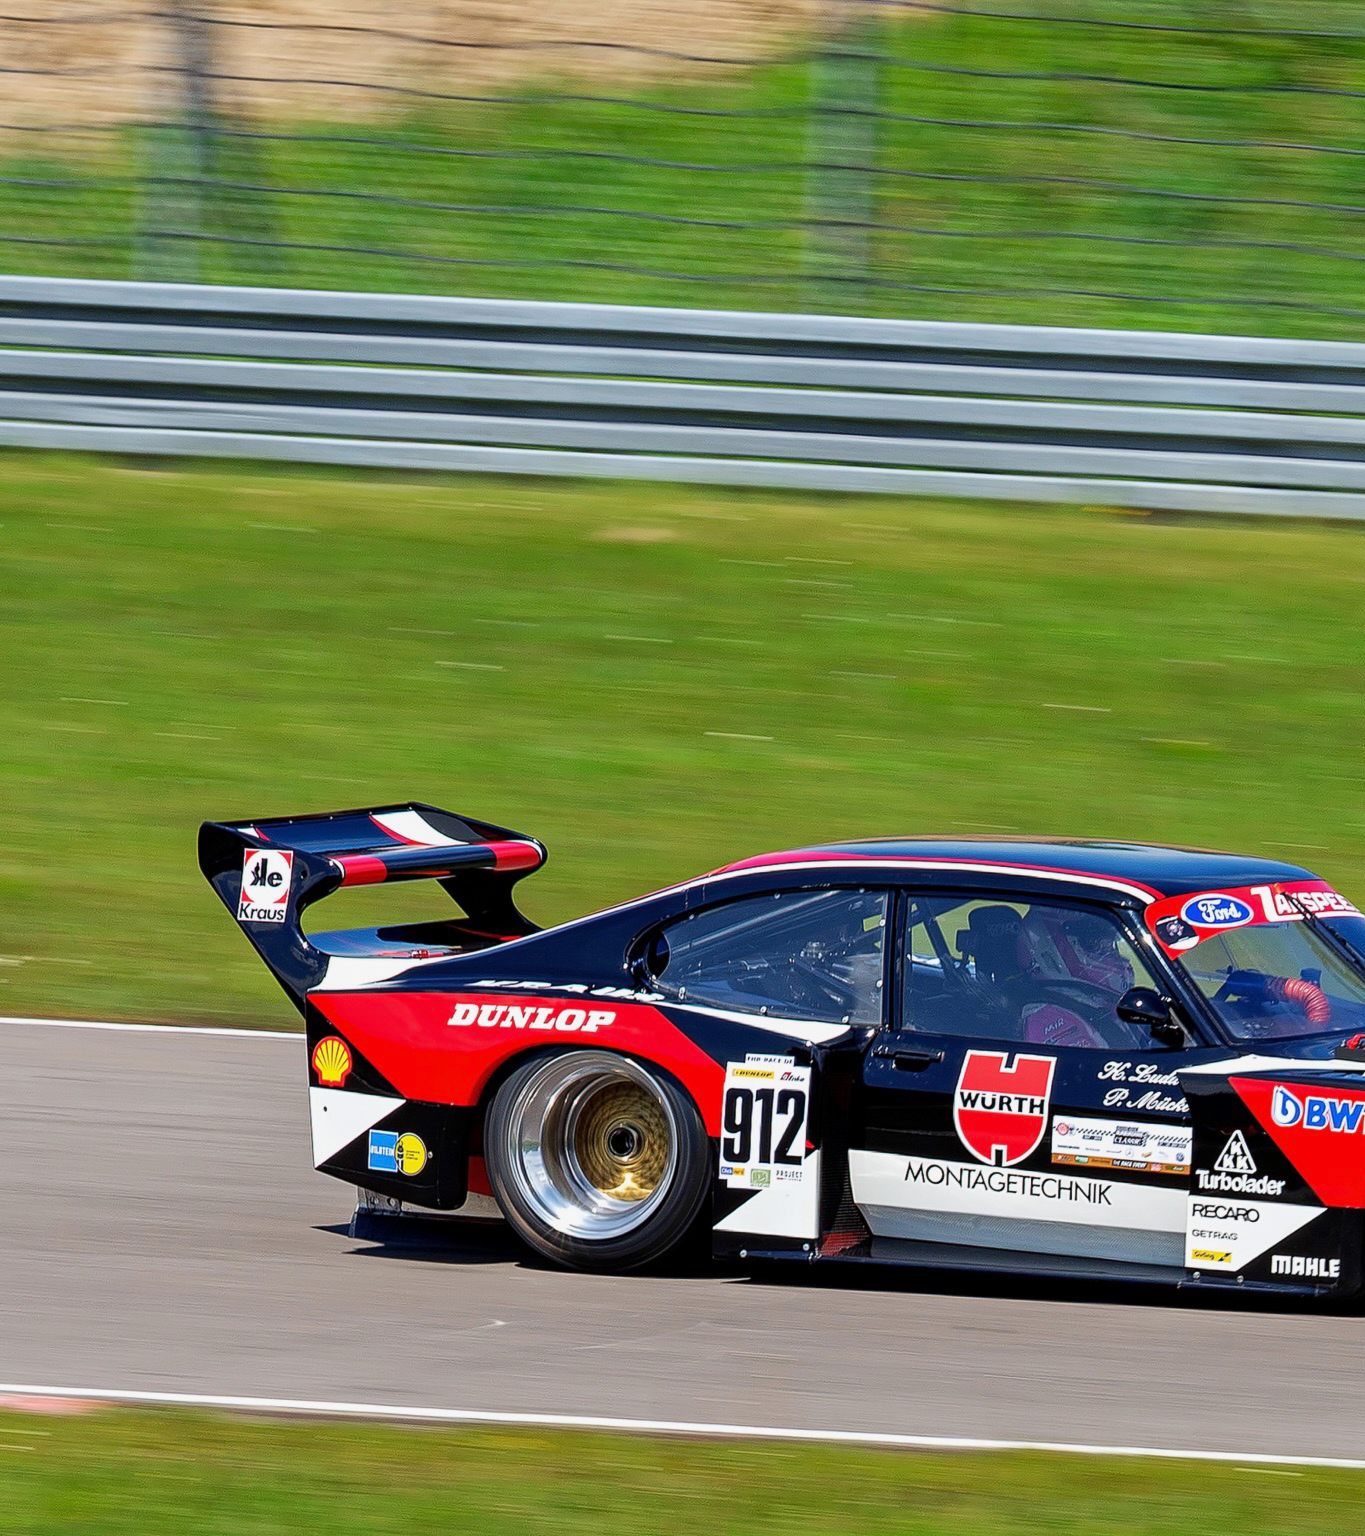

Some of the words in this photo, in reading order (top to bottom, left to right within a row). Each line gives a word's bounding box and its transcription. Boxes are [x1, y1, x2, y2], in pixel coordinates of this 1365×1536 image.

[239, 903, 284, 921] Kraus
[1197, 898, 1242, 924] Ford
[447, 1003, 616, 1032] DUNLOP
[960, 1091, 1045, 1115] WÜRTH
[1102, 1088, 1130, 1107] P.
[723, 1088, 806, 1165] 912
[903, 1161, 1112, 1205] MONTAGETECHNIK
[1195, 1169, 1286, 1196] Turbolader
[1192, 1204, 1260, 1222] RECARO
[1192, 1229, 1238, 1240] GETRAG
[1271, 1254, 1340, 1278] MAHLE
